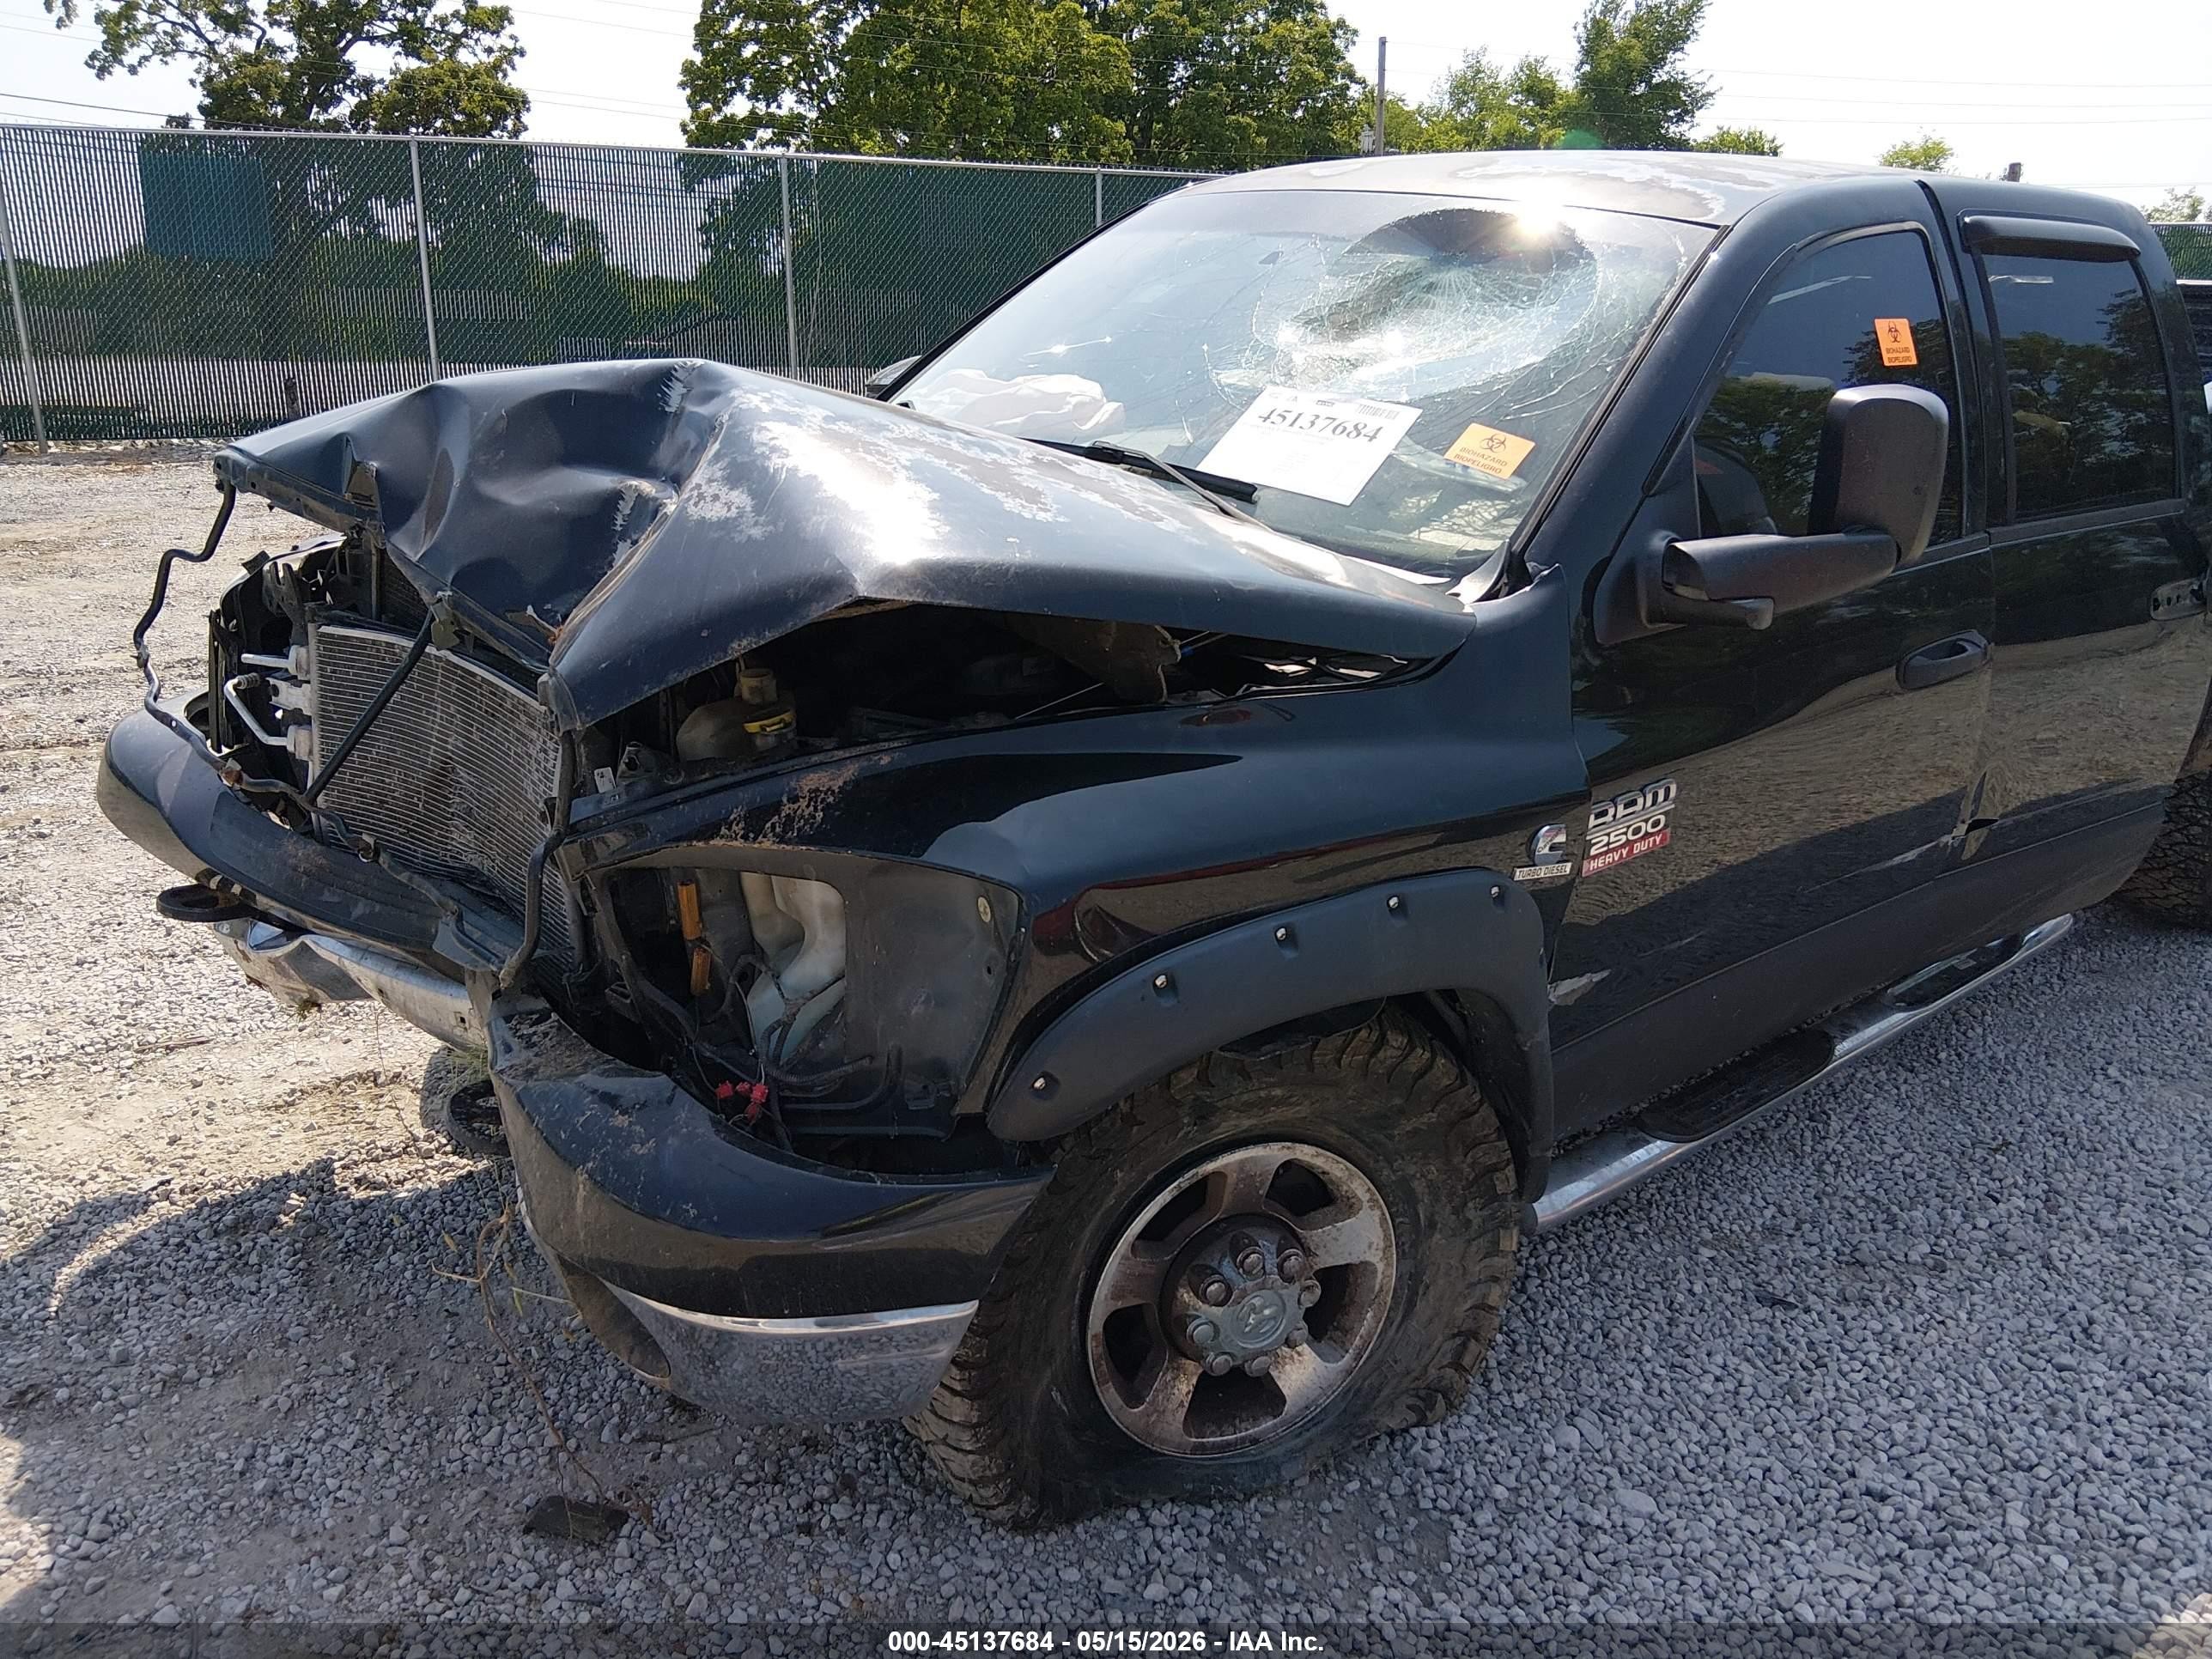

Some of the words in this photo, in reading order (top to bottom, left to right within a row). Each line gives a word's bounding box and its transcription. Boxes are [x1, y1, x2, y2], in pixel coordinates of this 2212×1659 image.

[1258, 407, 1383, 443] 45137684
[1454, 453, 1502, 474] BIOPELIGRO
[1461, 447, 1508, 467] BIOHAZARD
[1589, 778, 1676, 830] RAM
[1589, 814, 1666, 856] 2500
[1589, 847, 1629, 871] HEAVY
[1633, 833, 1662, 854] DUTY
[1517, 867, 1543, 878] TURBO
[1545, 864, 1568, 876] DIESEL
